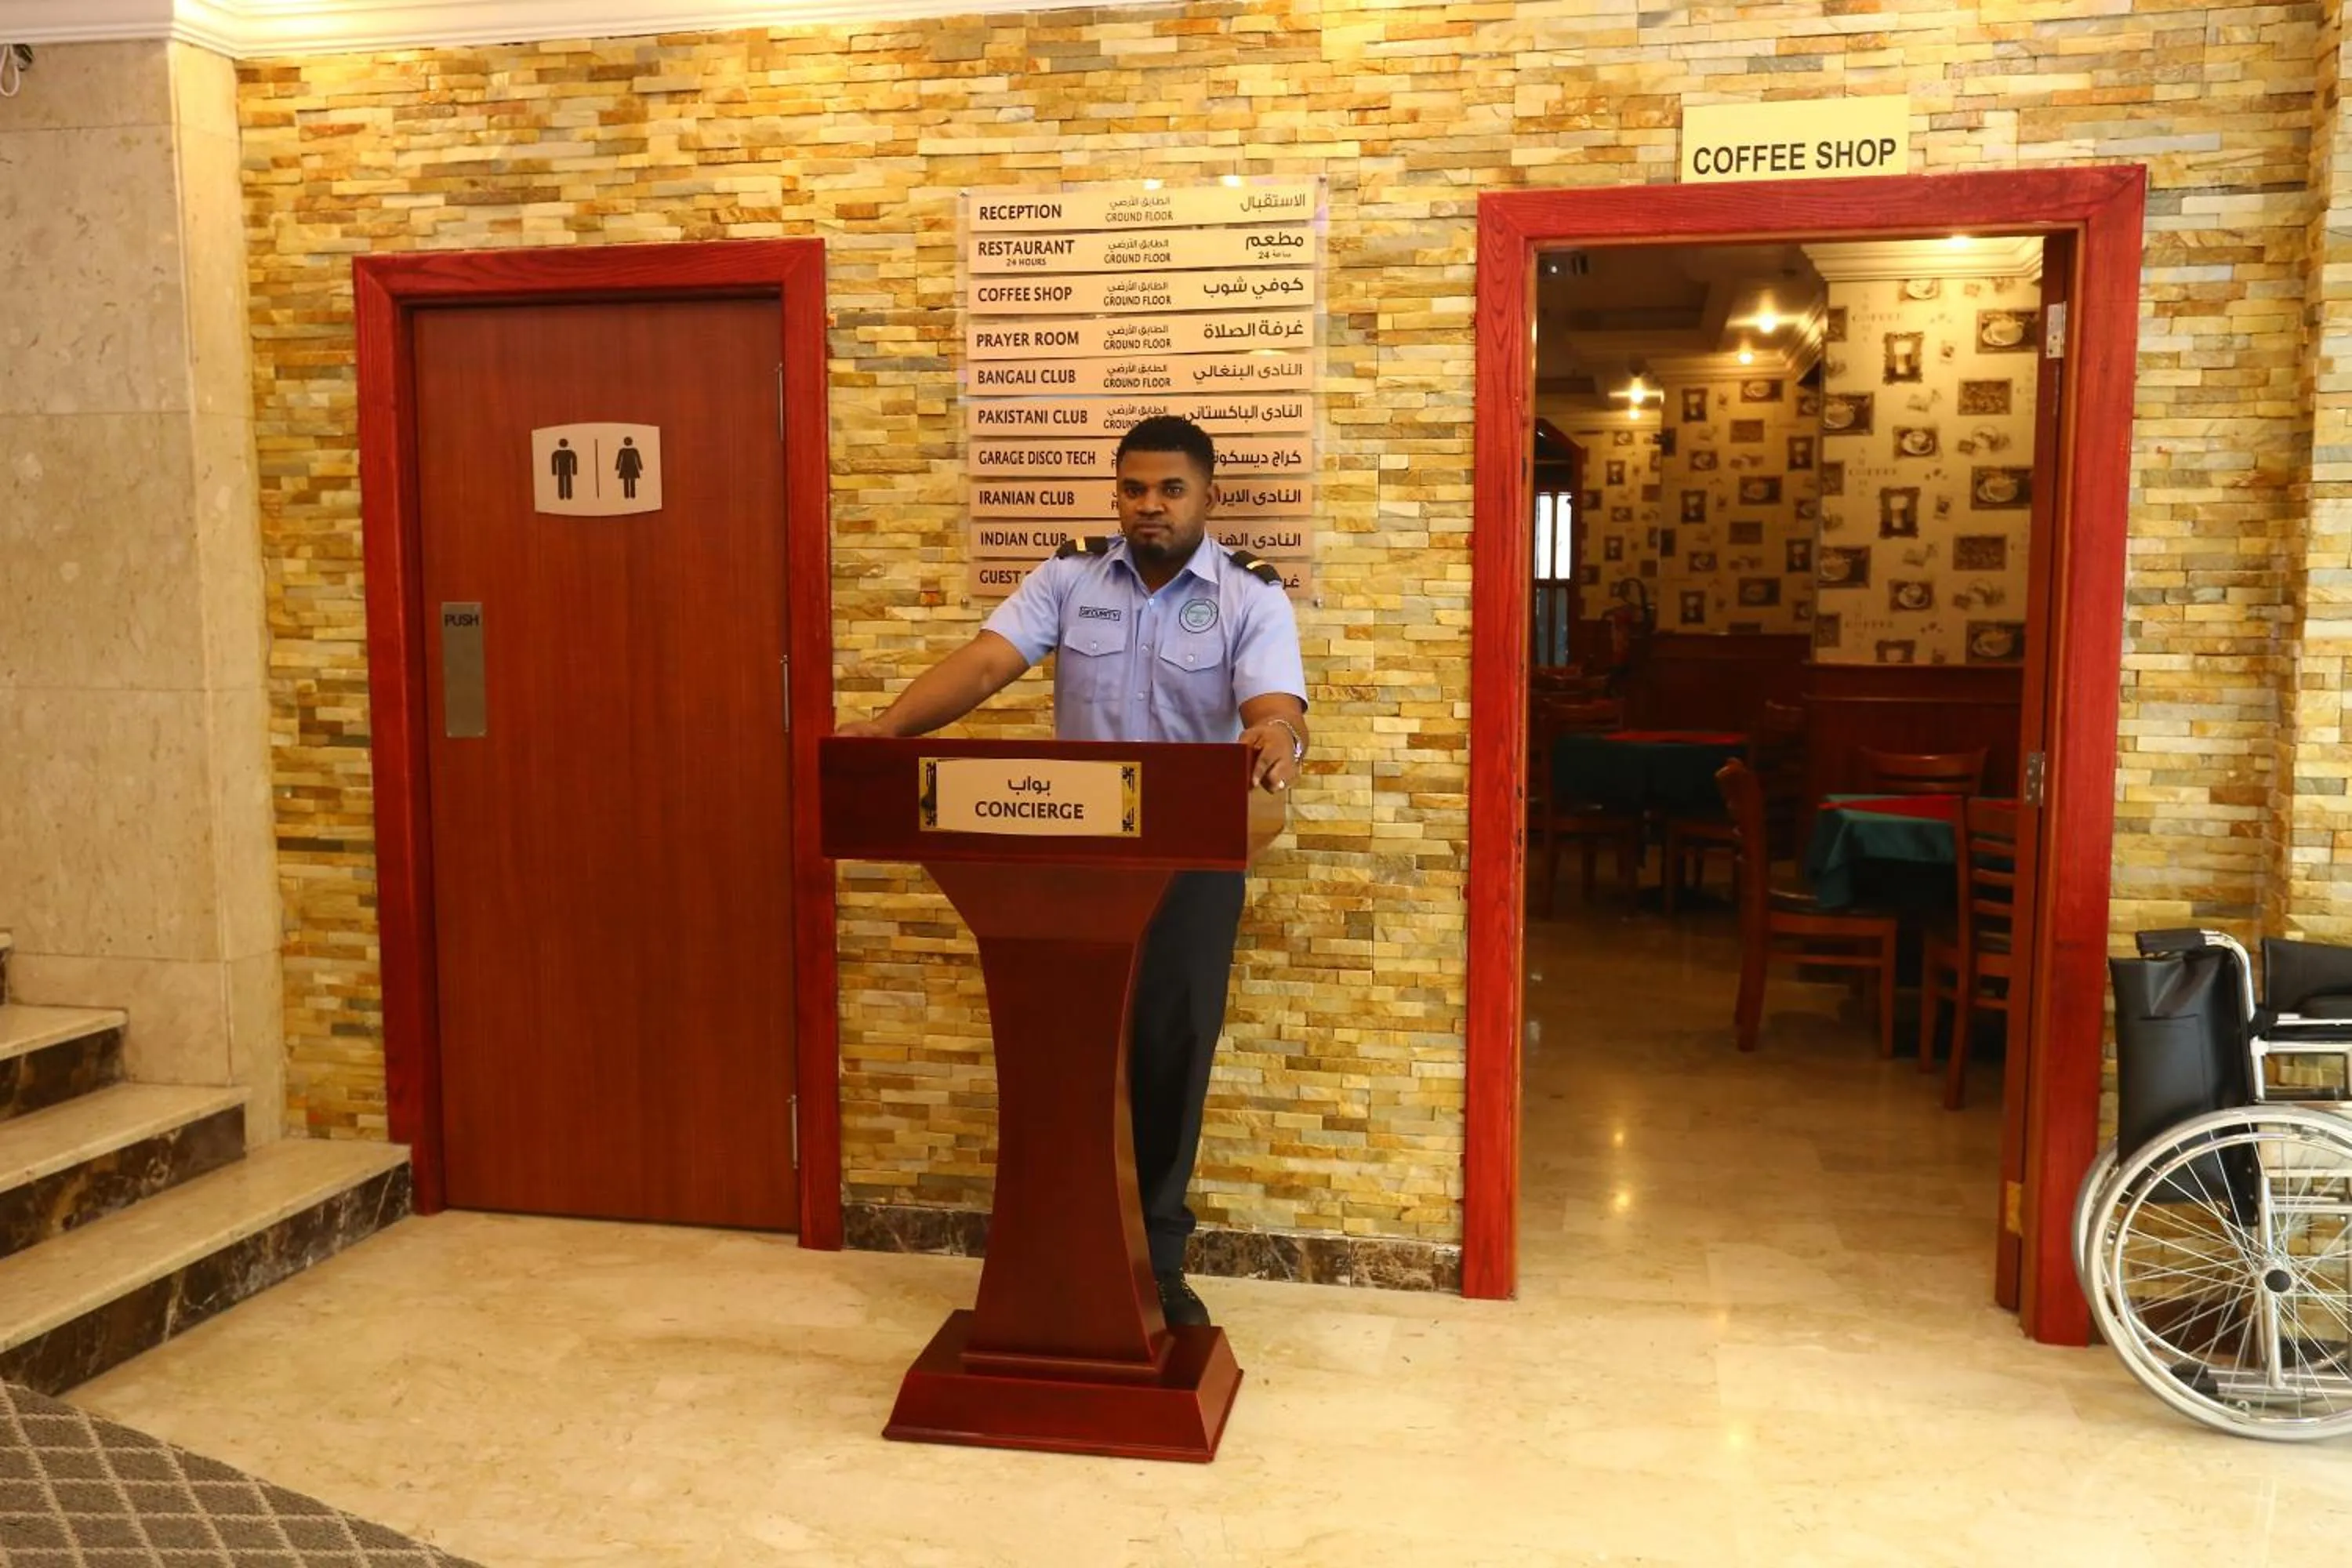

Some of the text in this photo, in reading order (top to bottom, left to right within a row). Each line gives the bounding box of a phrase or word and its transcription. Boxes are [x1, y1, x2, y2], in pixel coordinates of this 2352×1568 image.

[1693, 138, 1896, 175] COFFEE SHOP
[1240, 193, 1306, 212] الاستقبال
[979, 204, 1062, 220] RECEPTION
[1105, 210, 1174, 223] GROUND FLOOR
[978, 239, 1075, 256] RESTAURANT
[1246, 231, 1304, 251] مطعم
[1018, 258, 1047, 267] HOURS
[1104, 252, 1171, 264] GROUND FLOOR
[978, 286, 1073, 302] COFFEE SHOP
[1203, 276, 1304, 299] كوفي شوب
[1103, 294, 1171, 307] GROUND FLOOR
[1203, 319, 1304, 339] غرفة الصلاة
[976, 331, 1080, 347] PRAYER ROOM
[1103, 338, 1171, 350] GROUND FLOOR
[978, 368, 1076, 385] BANGALI CLUB
[1103, 377, 1171, 388] GROUND FLOOR
[1192, 364, 1254, 385] البنغالي
[978, 409, 1088, 424] PAKISTANI CLUB
[978, 451, 1025, 465] GARAGE
[1028, 451, 1063, 465] DISCO
[1065, 451, 1096, 465] TECH
[1272, 449, 1302, 466] كراج
[978, 490, 1075, 506] IRANIAN CLUB
[980, 532, 1067, 546] INDIAN CLUB
[979, 570, 1021, 584] GUEST
[445, 614, 480, 626] PUSH
[1007, 776, 1051, 796] بواب
[975, 800, 1085, 820] CONCIERGE
